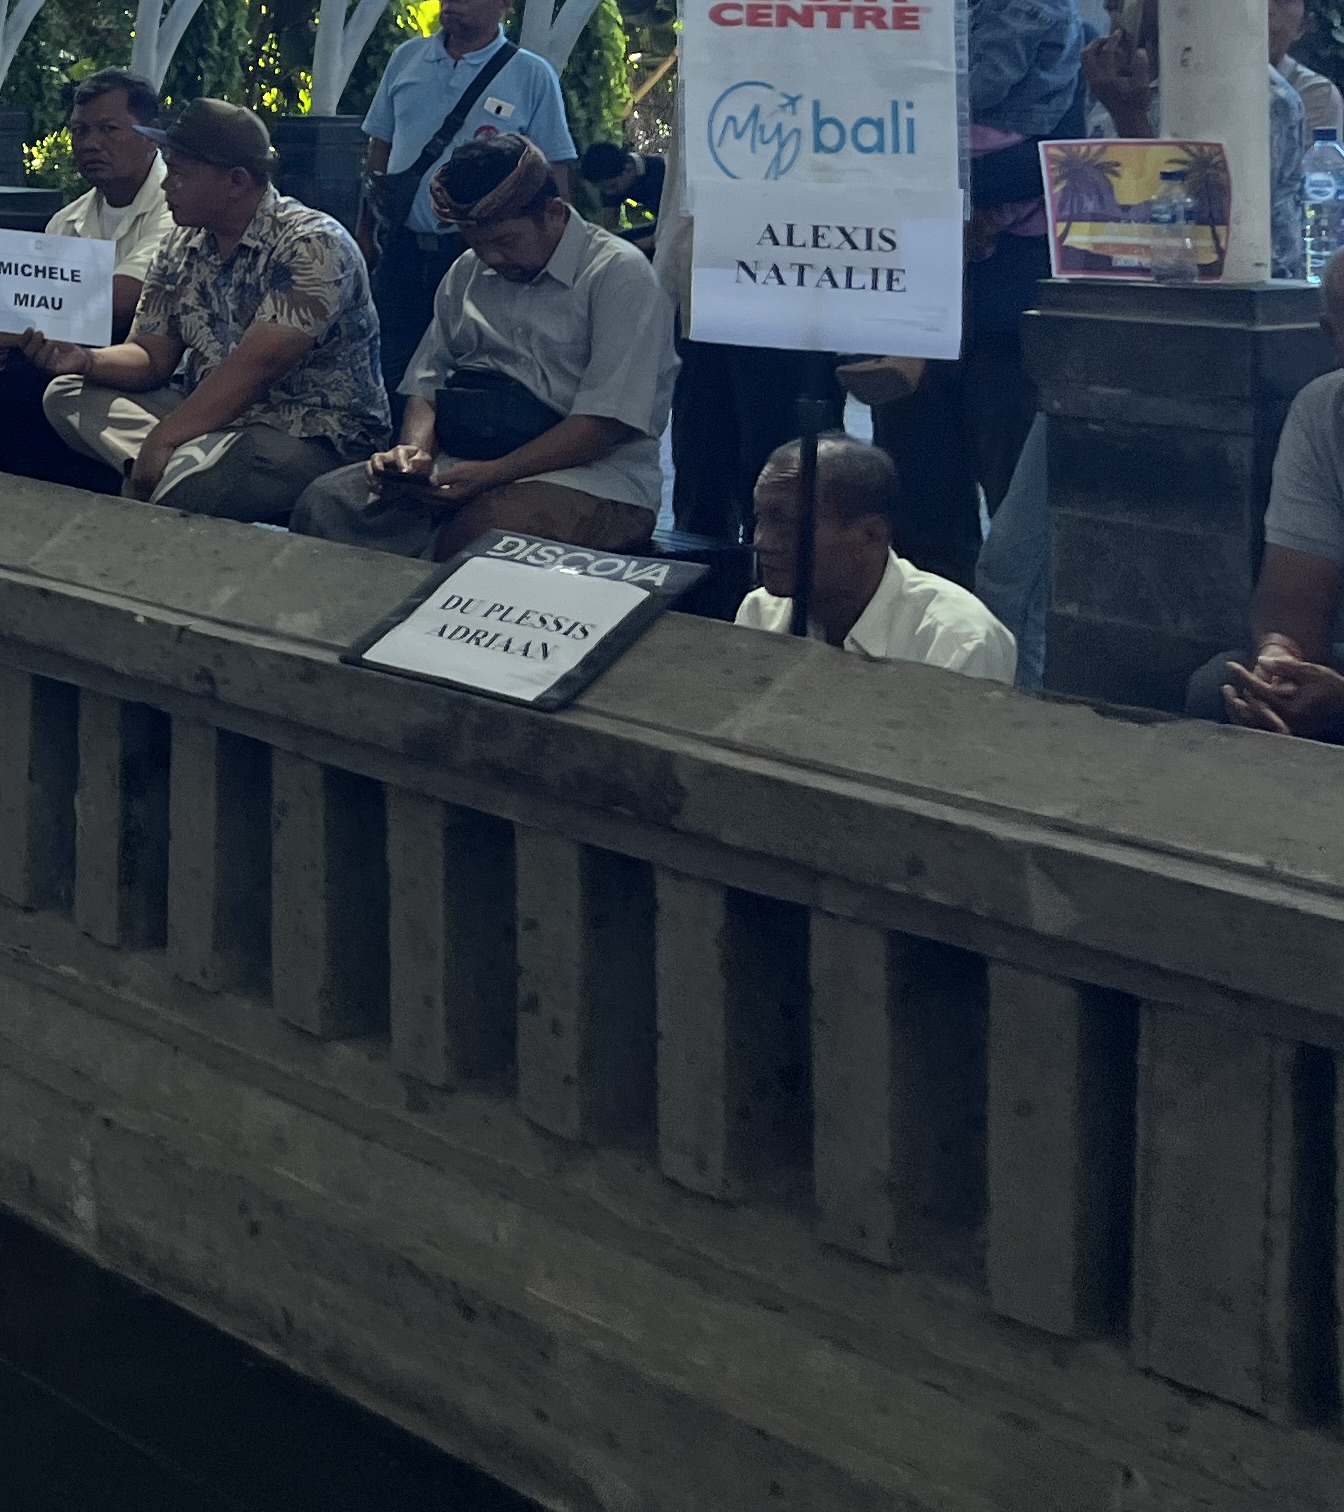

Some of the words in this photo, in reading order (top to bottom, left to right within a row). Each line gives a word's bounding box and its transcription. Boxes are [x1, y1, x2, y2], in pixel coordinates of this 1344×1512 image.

[709, 3, 921, 30] CENTRE
[812, 99, 915, 155] bali
[756, 223, 897, 252] ALEXIS
[735, 259, 906, 292] NATALIE
[13, 293, 63, 310] MIAU
[486, 535, 671, 586] DISCOVA
[439, 594, 476, 614] DU
[483, 603, 596, 640] PLESSIS
[425, 623, 560, 660] ADRIAAN
